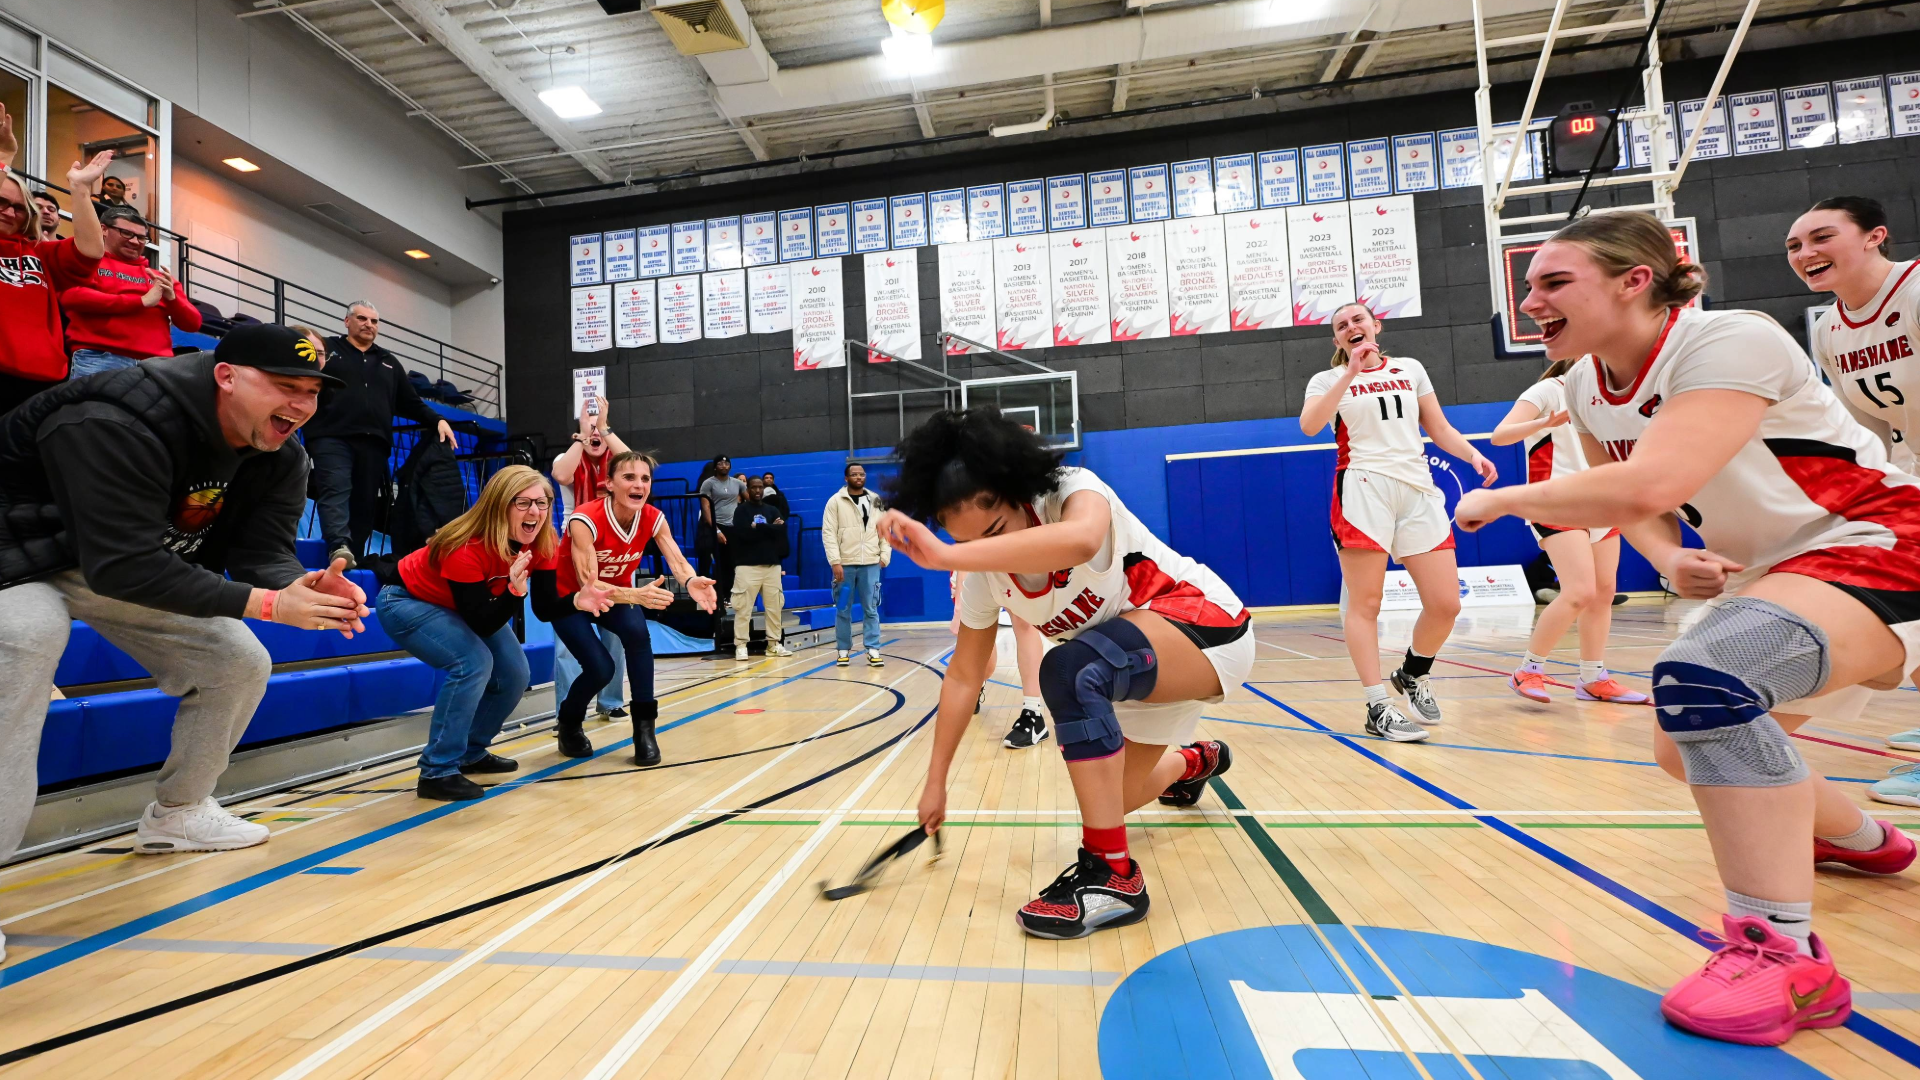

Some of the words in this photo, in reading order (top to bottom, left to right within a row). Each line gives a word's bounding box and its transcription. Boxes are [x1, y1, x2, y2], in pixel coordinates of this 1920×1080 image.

[1850, 80, 1880, 91] CANADIAN
[1797, 88, 1826, 98] CANADIAN
[1733, 98, 1743, 106] ALL
[1745, 94, 1774, 104] CANADIAN
[1407, 138, 1430, 146] CANADIAN
[1738, 137, 1779, 146] BASKETBALL
[1361, 143, 1384, 152] CANADIAN
[1316, 148, 1339, 157] CANADIAN
[1272, 154, 1294, 162] CANADIAN
[1228, 159, 1250, 167] CANADIAN
[1185, 164, 1207, 172] CANADIAN
[1142, 169, 1163, 177] CANADIAN
[1101, 174, 1122, 182] CANADIAN
[1019, 184, 1040, 192] CANADIAN
[941, 192, 962, 201] CANADIAN
[718, 219, 737, 227] CANADIAN
[753, 215, 774, 223] CANADIAN
[683, 223, 702, 231] CANADIAN
[649, 228, 667, 236] CANADIAN
[1372, 228, 1394, 236] 2023
[1246, 240, 1268, 248] 2022
[1303, 245, 1336, 253] WOMEN'S
[1127, 252, 1146, 260] 2018
[1300, 250, 1342, 259] BASKETBALL
[1237, 257, 1279, 265] BASKETBALL
[1360, 259, 1411, 269] MEDALISTS
[1176, 262, 1217, 271] BASKETBALL
[1297, 265, 1347, 275] MEDALISTS
[1234, 270, 1284, 281] MEDALISTS
[1180, 277, 1215, 286] BRONZE
[1365, 276, 1408, 284] BASKETBALL
[1124, 283, 1152, 291] SILVER
[1239, 287, 1281, 295] BASKETBALL
[1010, 294, 1036, 302] SILVER
[954, 299, 980, 307] SILVER
[877, 307, 908, 315] BRONZE
[803, 315, 833, 323] BRONZE
[1350, 379, 1412, 397] FANSHAWE
[1855, 372, 1904, 408] 15
[1377, 394, 1404, 420] 11
[599, 564, 628, 578] 21
